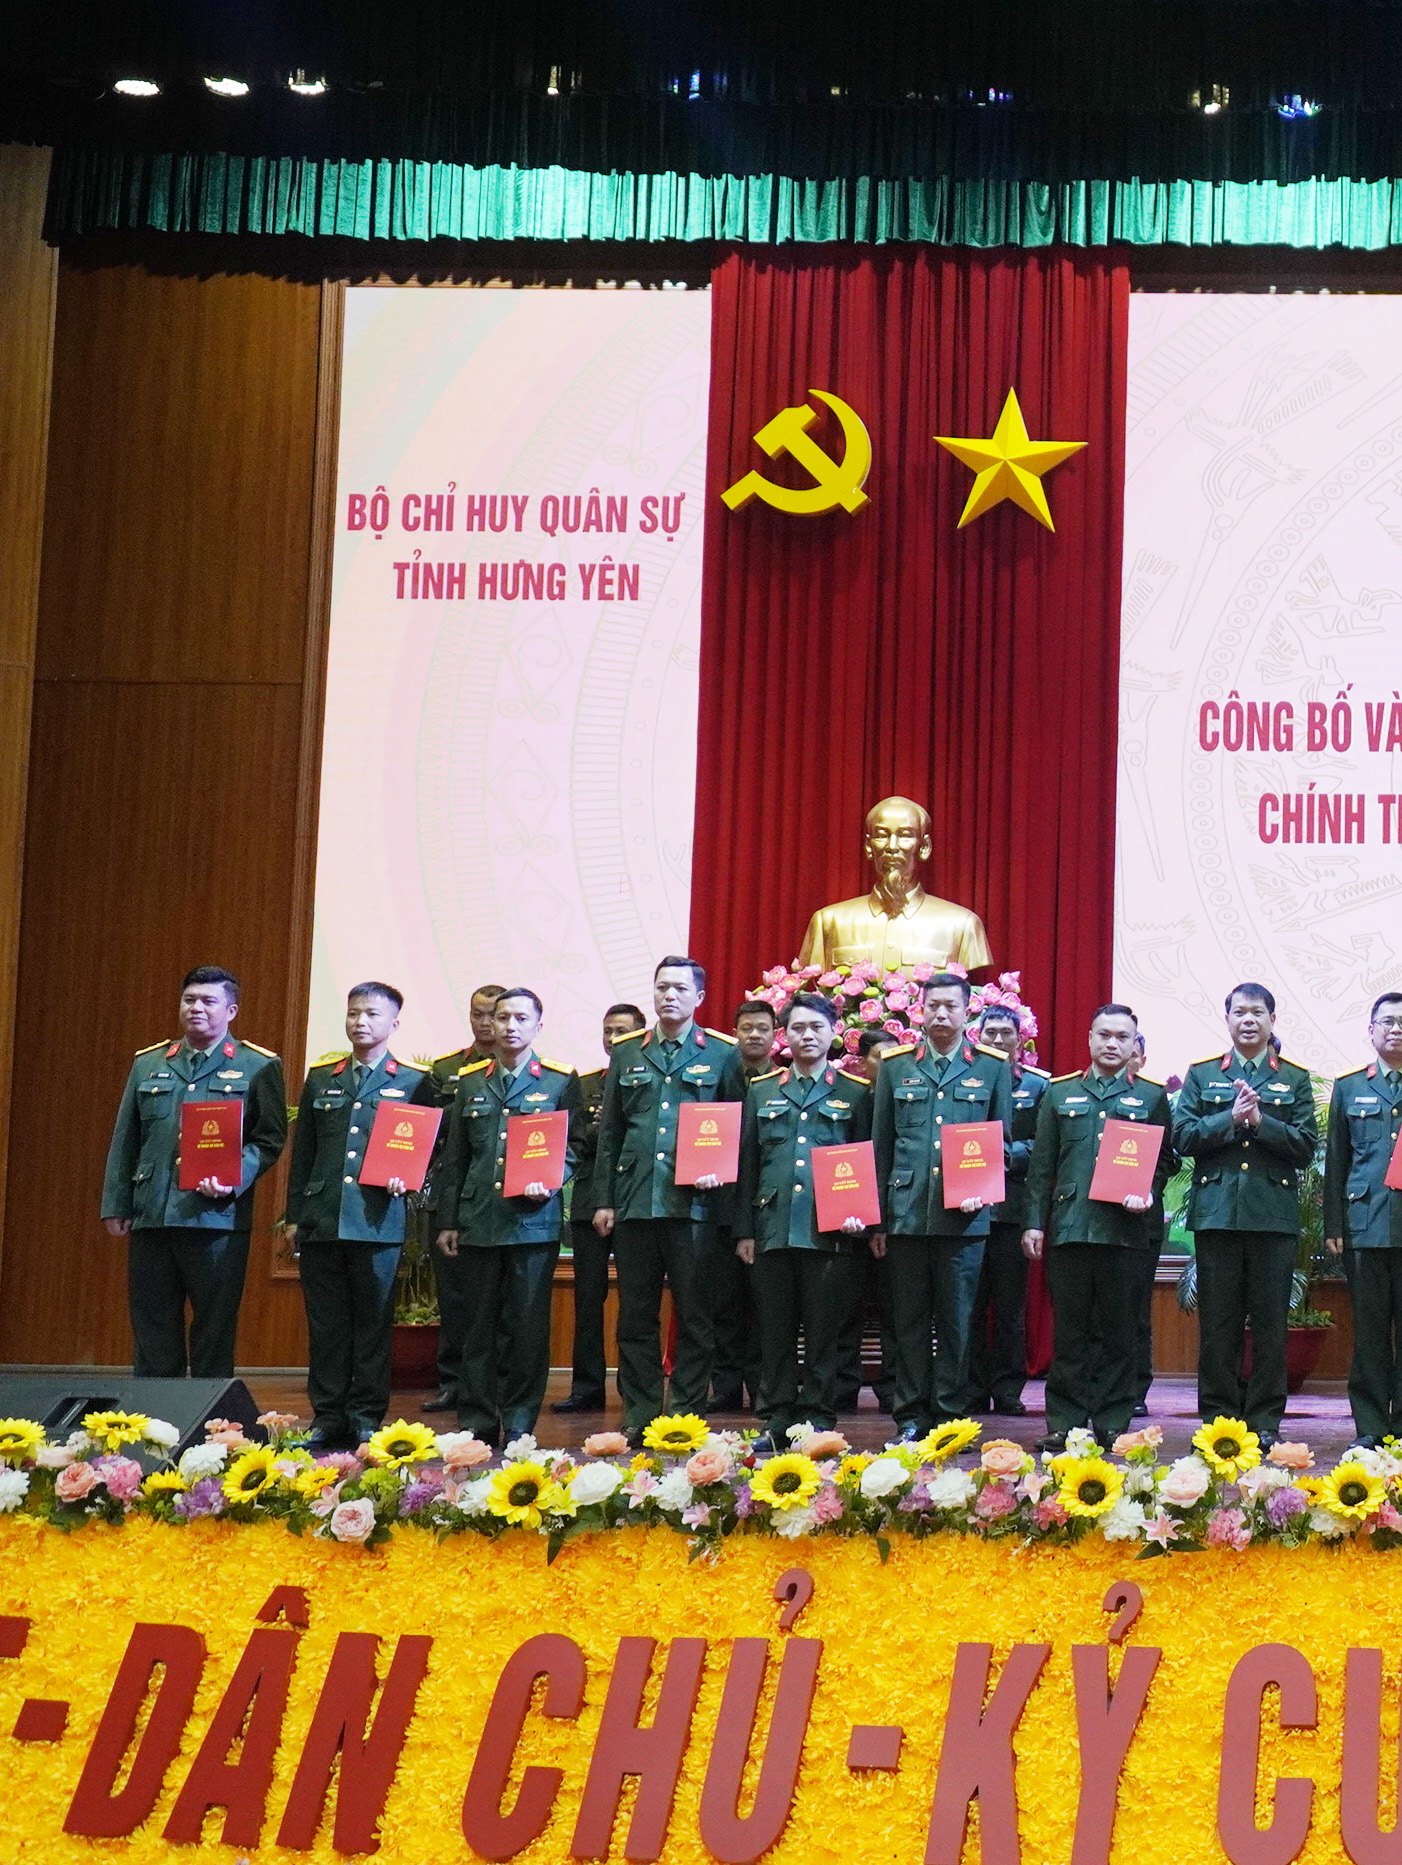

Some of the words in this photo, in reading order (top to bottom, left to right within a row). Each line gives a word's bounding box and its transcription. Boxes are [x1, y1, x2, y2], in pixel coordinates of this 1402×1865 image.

[347, 486, 390, 540] BỘ
[402, 482, 456, 531] CHỈ
[466, 495, 528, 533] HUY
[540, 488, 627, 537] QUÂN
[640, 493, 685, 542] SỰ
[393, 549, 466, 599] TỈNH
[478, 560, 566, 600] HƯNG
[579, 555, 639, 600] YÊN
[1200, 691, 1293, 752] CÔNG
[1307, 684, 1352, 752] BỐ
[1259, 782, 1365, 844] CHÍNH
[62, 1585, 434, 1857] DÂN
[461, 1567, 823, 1865] CHỦ
[923, 1580, 1162, 1865] KỶ
